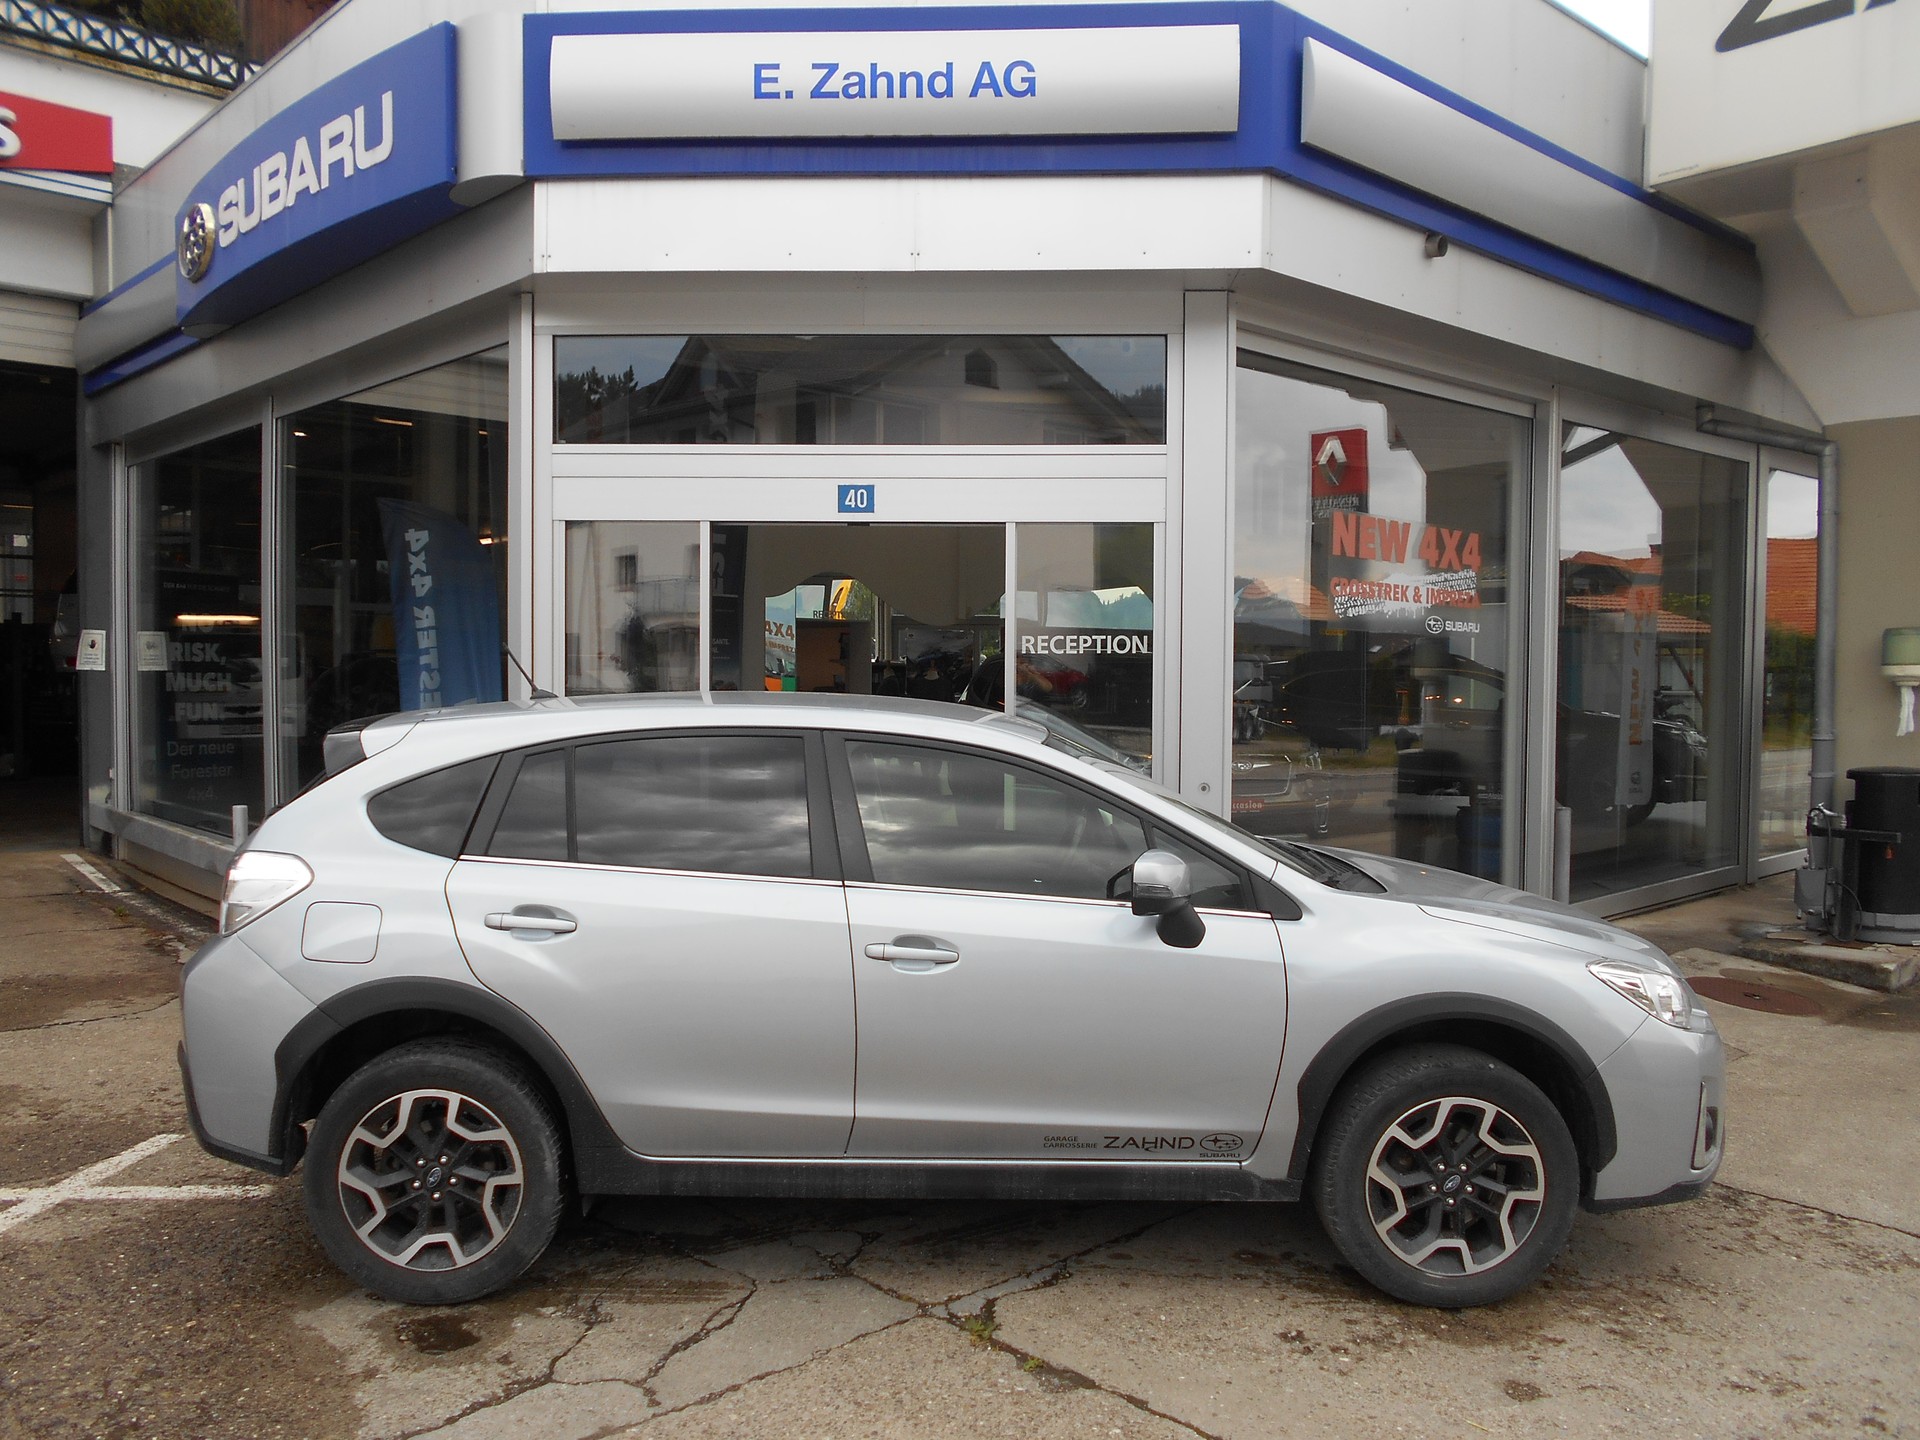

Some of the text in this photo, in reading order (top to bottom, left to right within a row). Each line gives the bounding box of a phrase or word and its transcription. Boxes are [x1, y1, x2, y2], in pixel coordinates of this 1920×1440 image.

[754, 60, 1036, 99] E. Zahnd AG
[218, 91, 393, 249] SUBARU
[845, 488, 867, 508] 40
[1332, 511, 1482, 574] NEW 4X4
[1330, 577, 1481, 609] CROSSTREK & IMPREZA
[1445, 621, 1480, 634] SUBARU
[171, 642, 227, 665] RISK,
[1021, 635, 1148, 654] RECEPTION
[166, 672, 232, 692] MUCH
[168, 740, 235, 757] Der neue
[171, 763, 233, 780] Forester
[1232, 799, 1263, 809] ccasion
[1103, 1136, 1195, 1151] ZAHND
